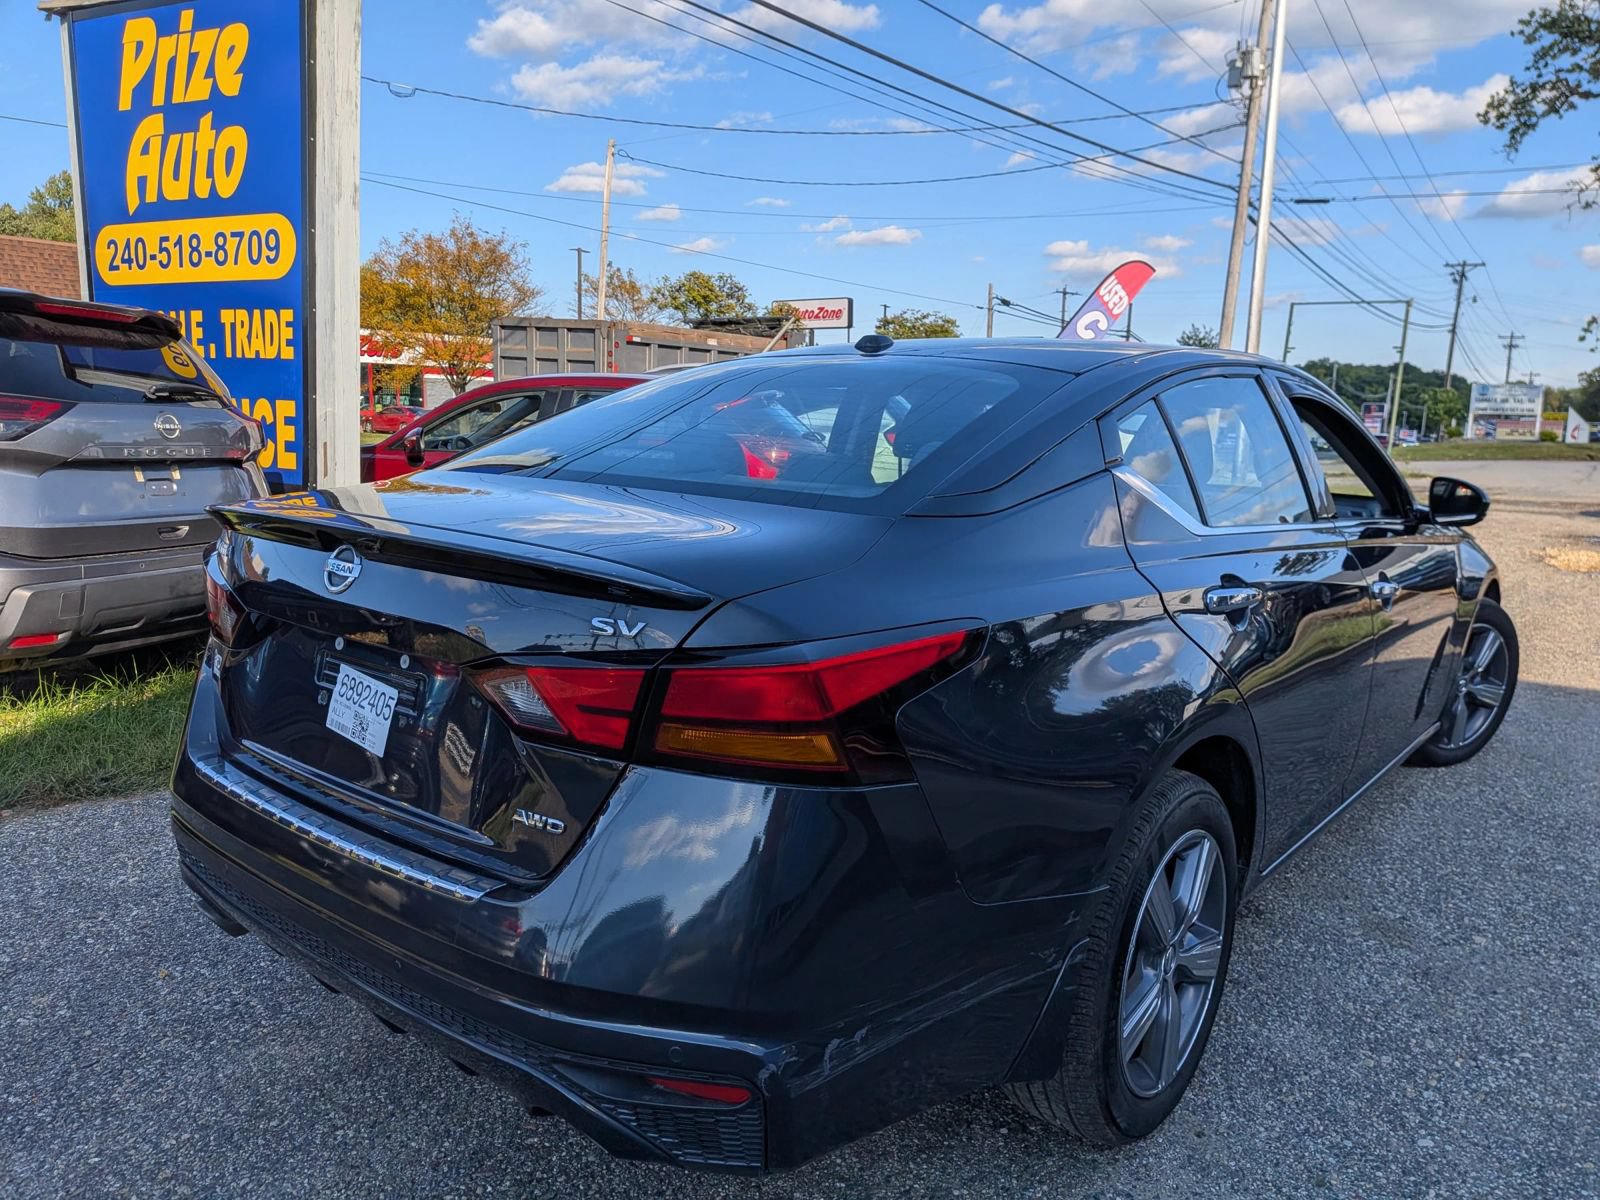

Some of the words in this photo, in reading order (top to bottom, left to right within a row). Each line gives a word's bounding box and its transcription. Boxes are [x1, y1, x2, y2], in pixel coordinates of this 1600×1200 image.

[118, 9, 250, 111] Prize
[126, 111, 249, 216] Auto
[106, 228, 281, 272] 240-518-8709
[1099, 274, 1129, 315] USED
[220, 309, 295, 359] TRADE
[123, 447, 212, 457] ROGUE
[590, 616, 648, 639] SV
[338, 673, 396, 721] 6892405
[512, 808, 565, 833] AWD
